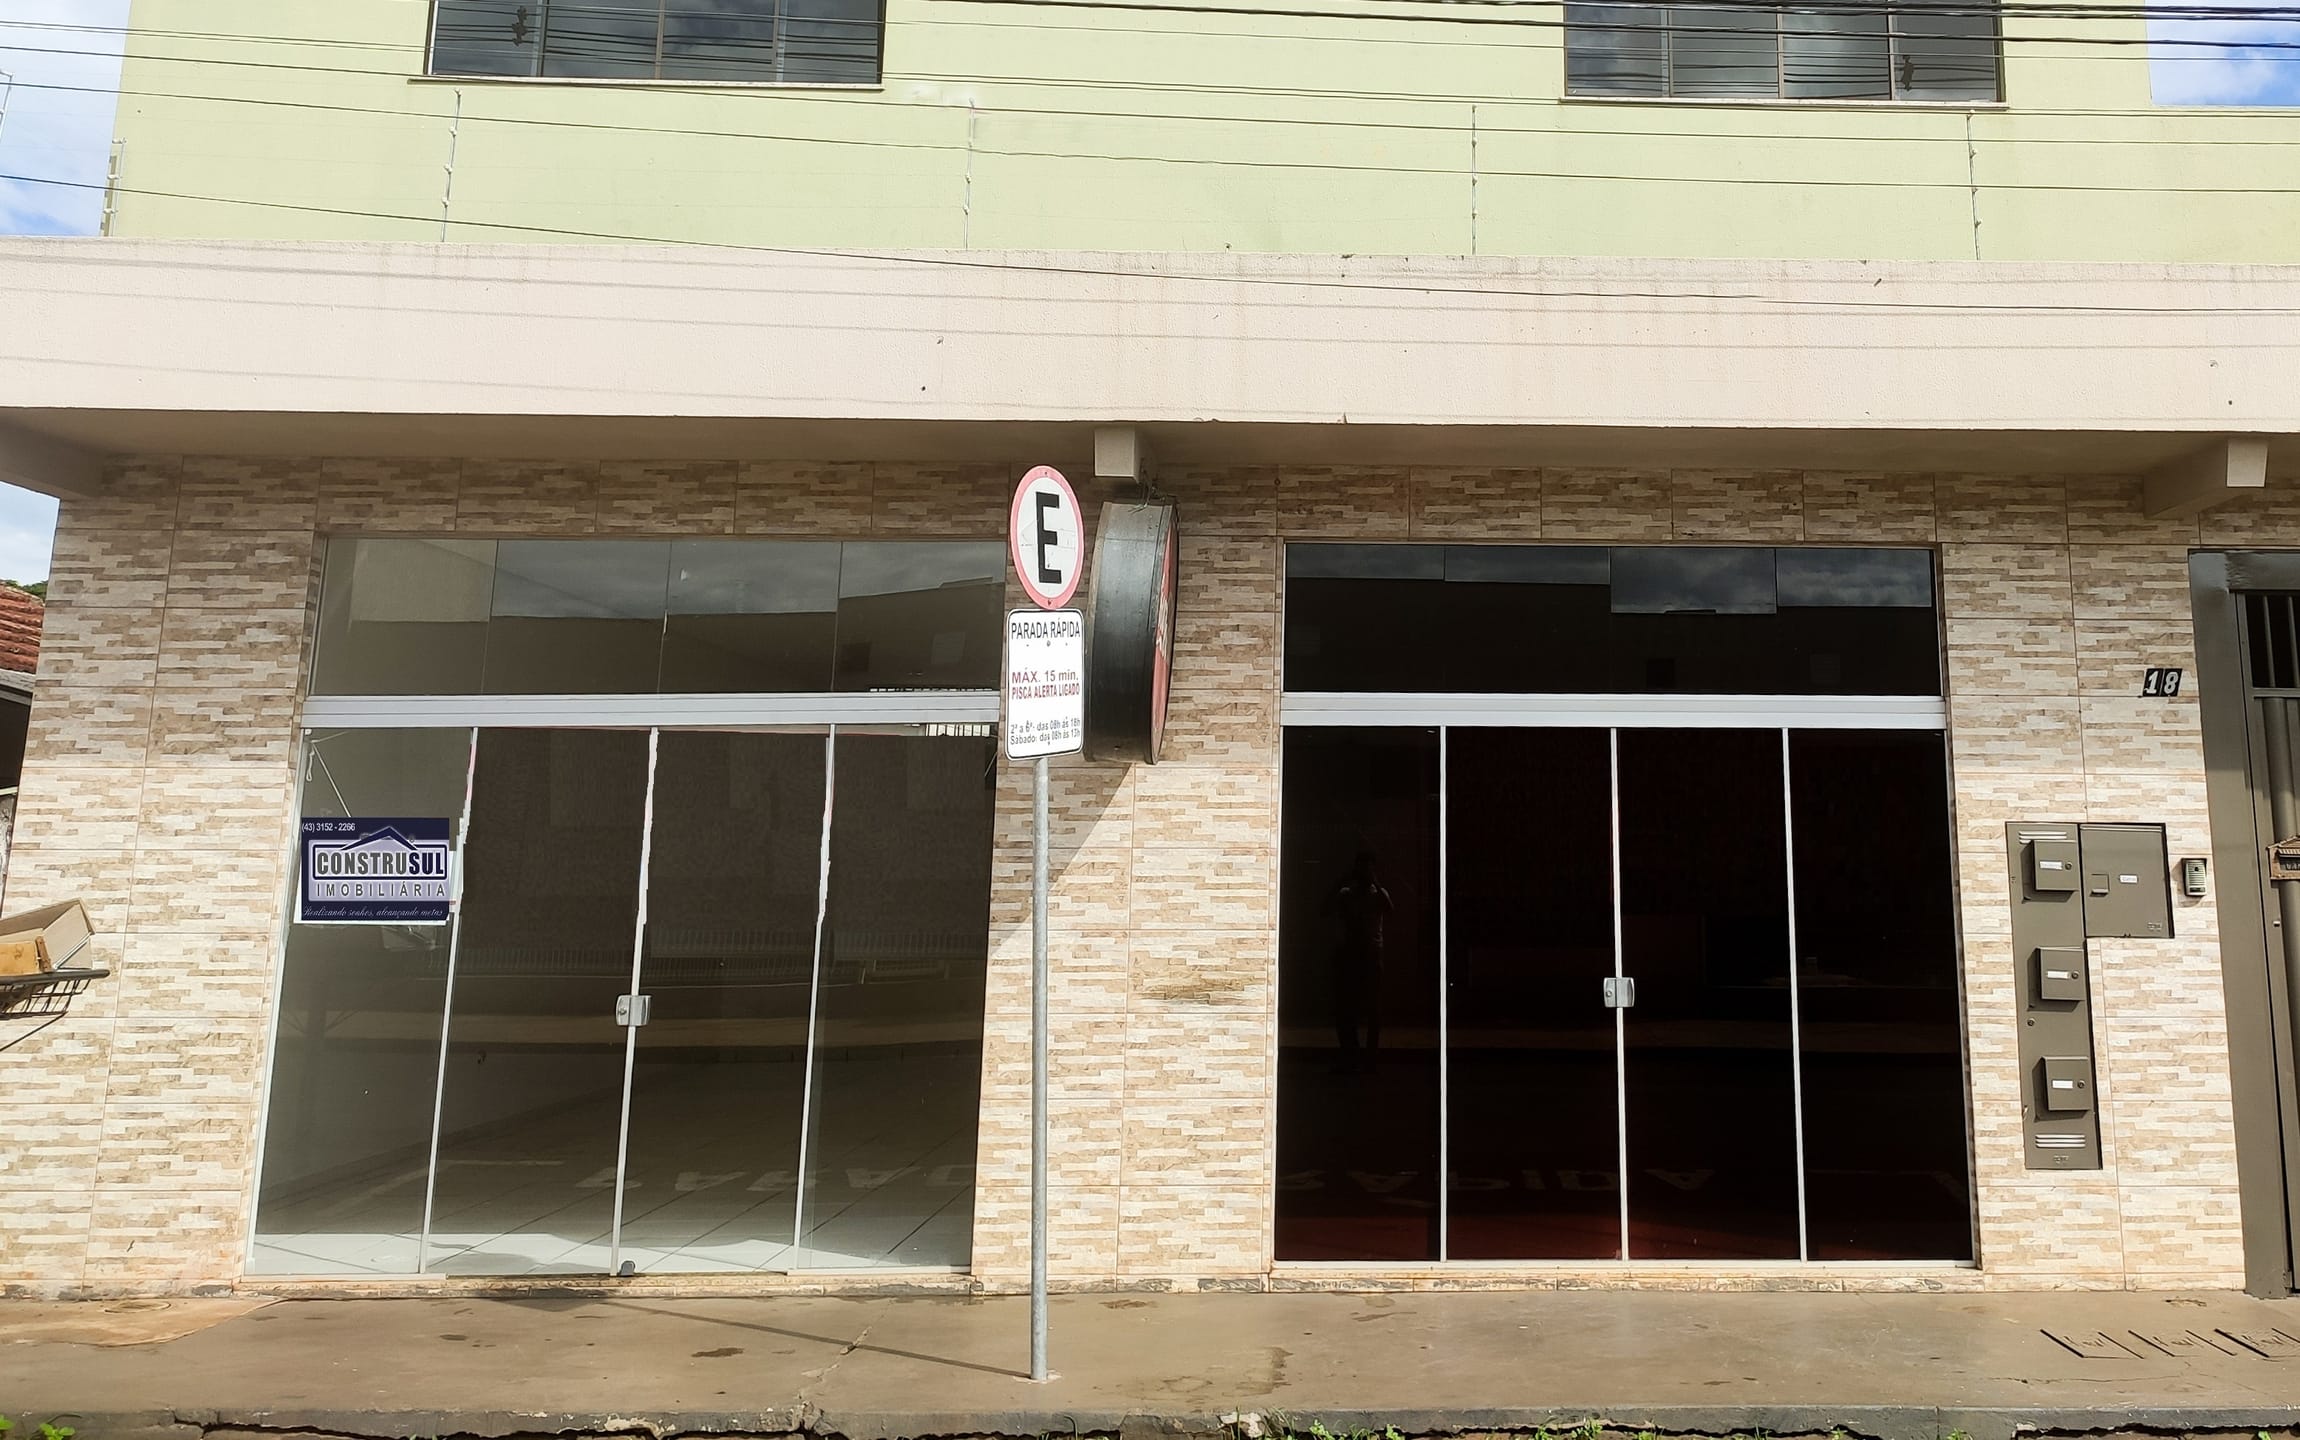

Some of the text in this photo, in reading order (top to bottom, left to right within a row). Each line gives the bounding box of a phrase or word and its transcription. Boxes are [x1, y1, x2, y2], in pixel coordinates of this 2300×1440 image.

[1035, 491, 1062, 584] E
[1011, 617, 1080, 640] PARADA RÁPIDA
[1011, 667, 1079, 684] MÁX. 15 min.
[2144, 671, 2178, 694] 18
[1011, 682, 1080, 700] PISCA ALERTA LIGADO
[1037, 721, 1049, 731] das
[1039, 732, 1050, 742] das
